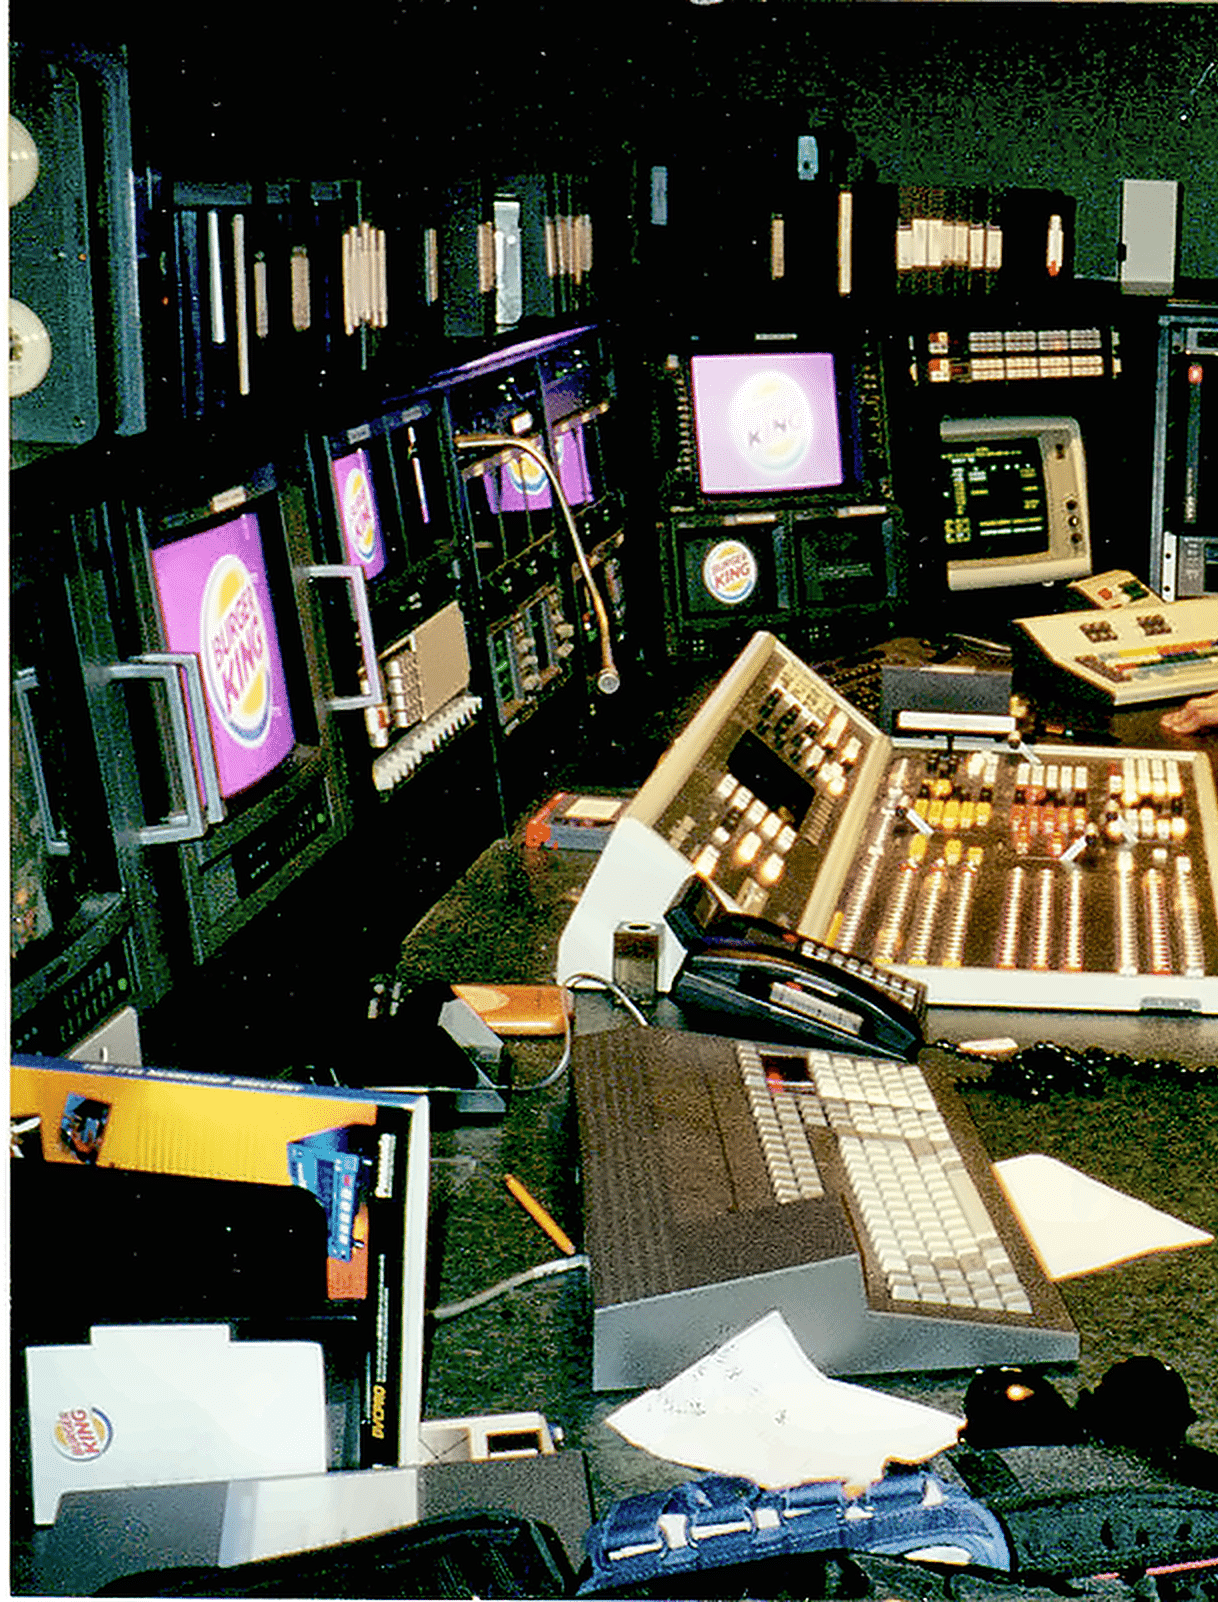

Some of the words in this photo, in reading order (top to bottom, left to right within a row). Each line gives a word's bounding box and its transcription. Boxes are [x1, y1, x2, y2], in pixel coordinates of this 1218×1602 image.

[748, 416, 797, 447] KN
[714, 561, 750, 590] KING
[212, 585, 259, 673] BURGER
[221, 614, 264, 717] KING
[70, 1408, 100, 1453] KING
